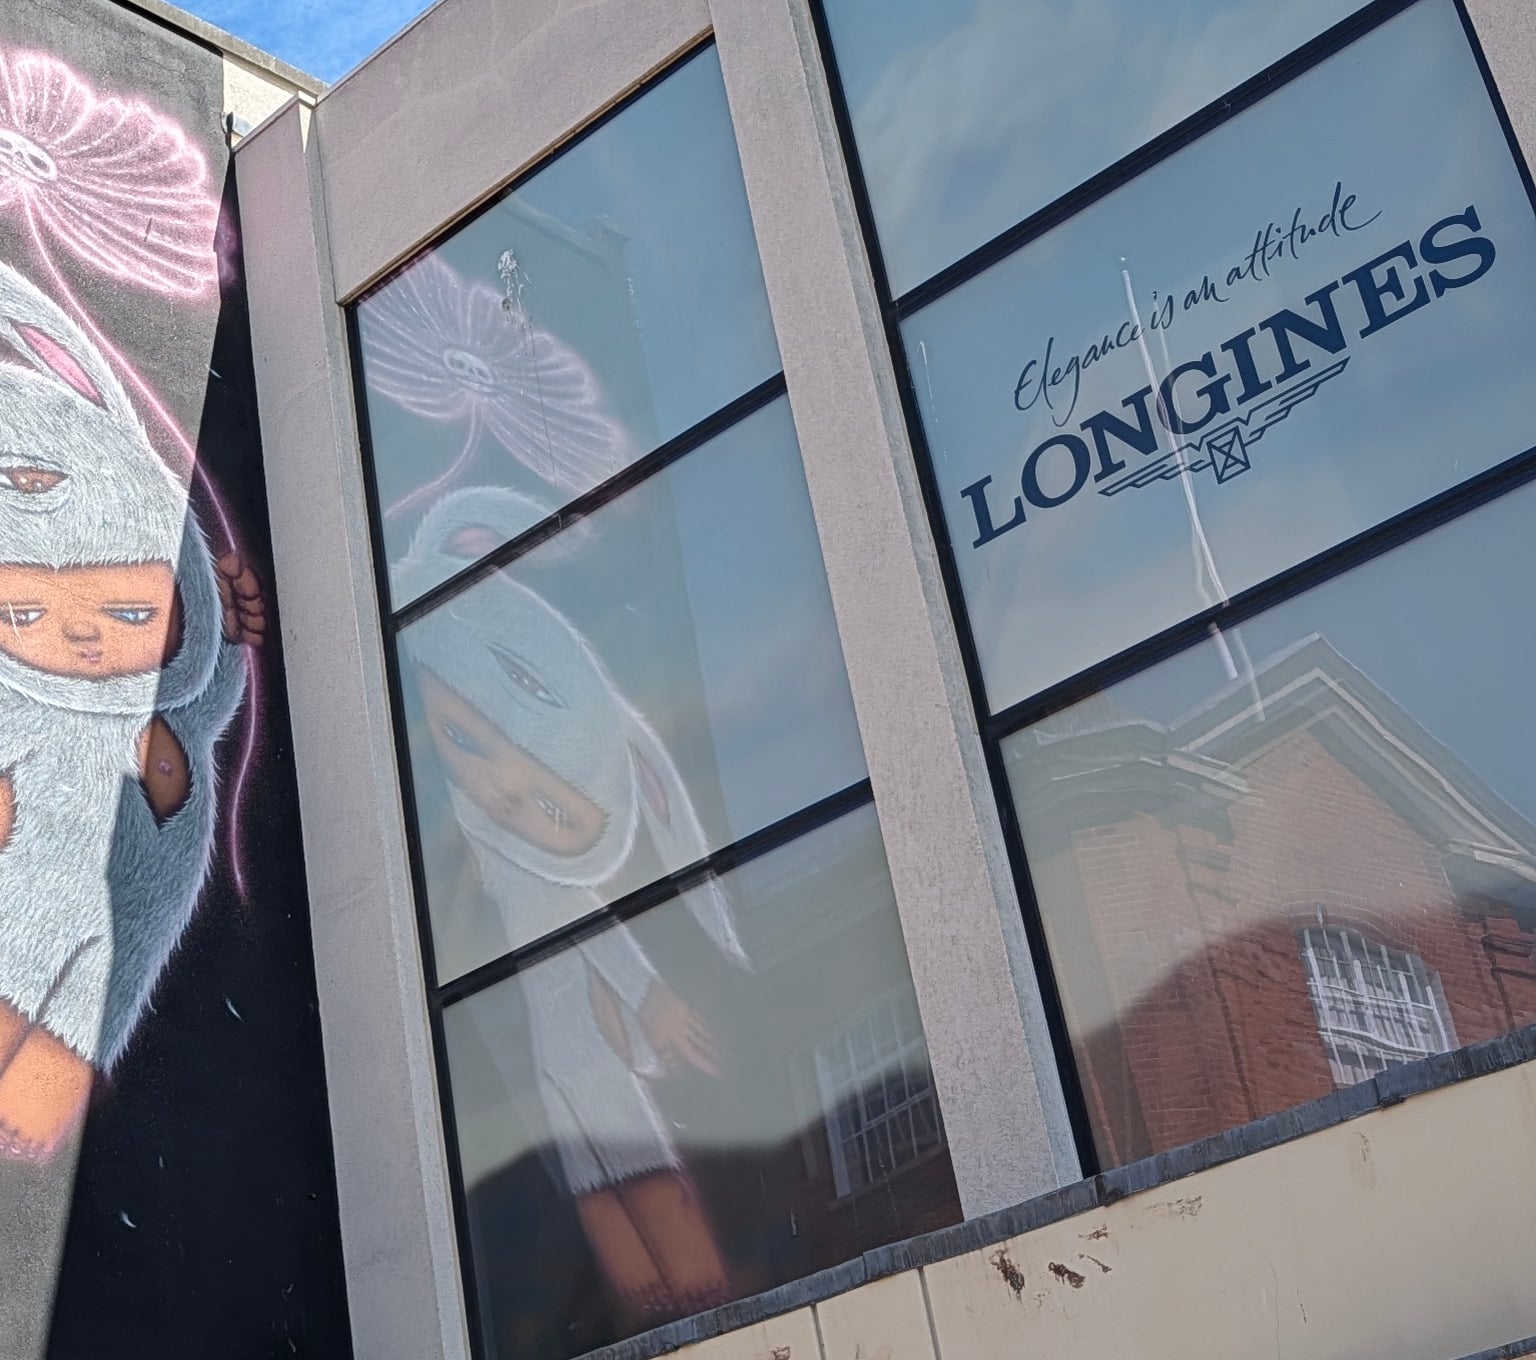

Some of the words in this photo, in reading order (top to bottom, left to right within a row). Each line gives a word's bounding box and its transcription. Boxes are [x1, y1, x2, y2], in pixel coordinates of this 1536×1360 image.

[960, 204, 1497, 548] LONGINES
[1013, 321, 1145, 426] Elegance
[1149, 291, 1175, 330] is
[1183, 281, 1229, 317] an
[1226, 181, 1383, 286] attitude
